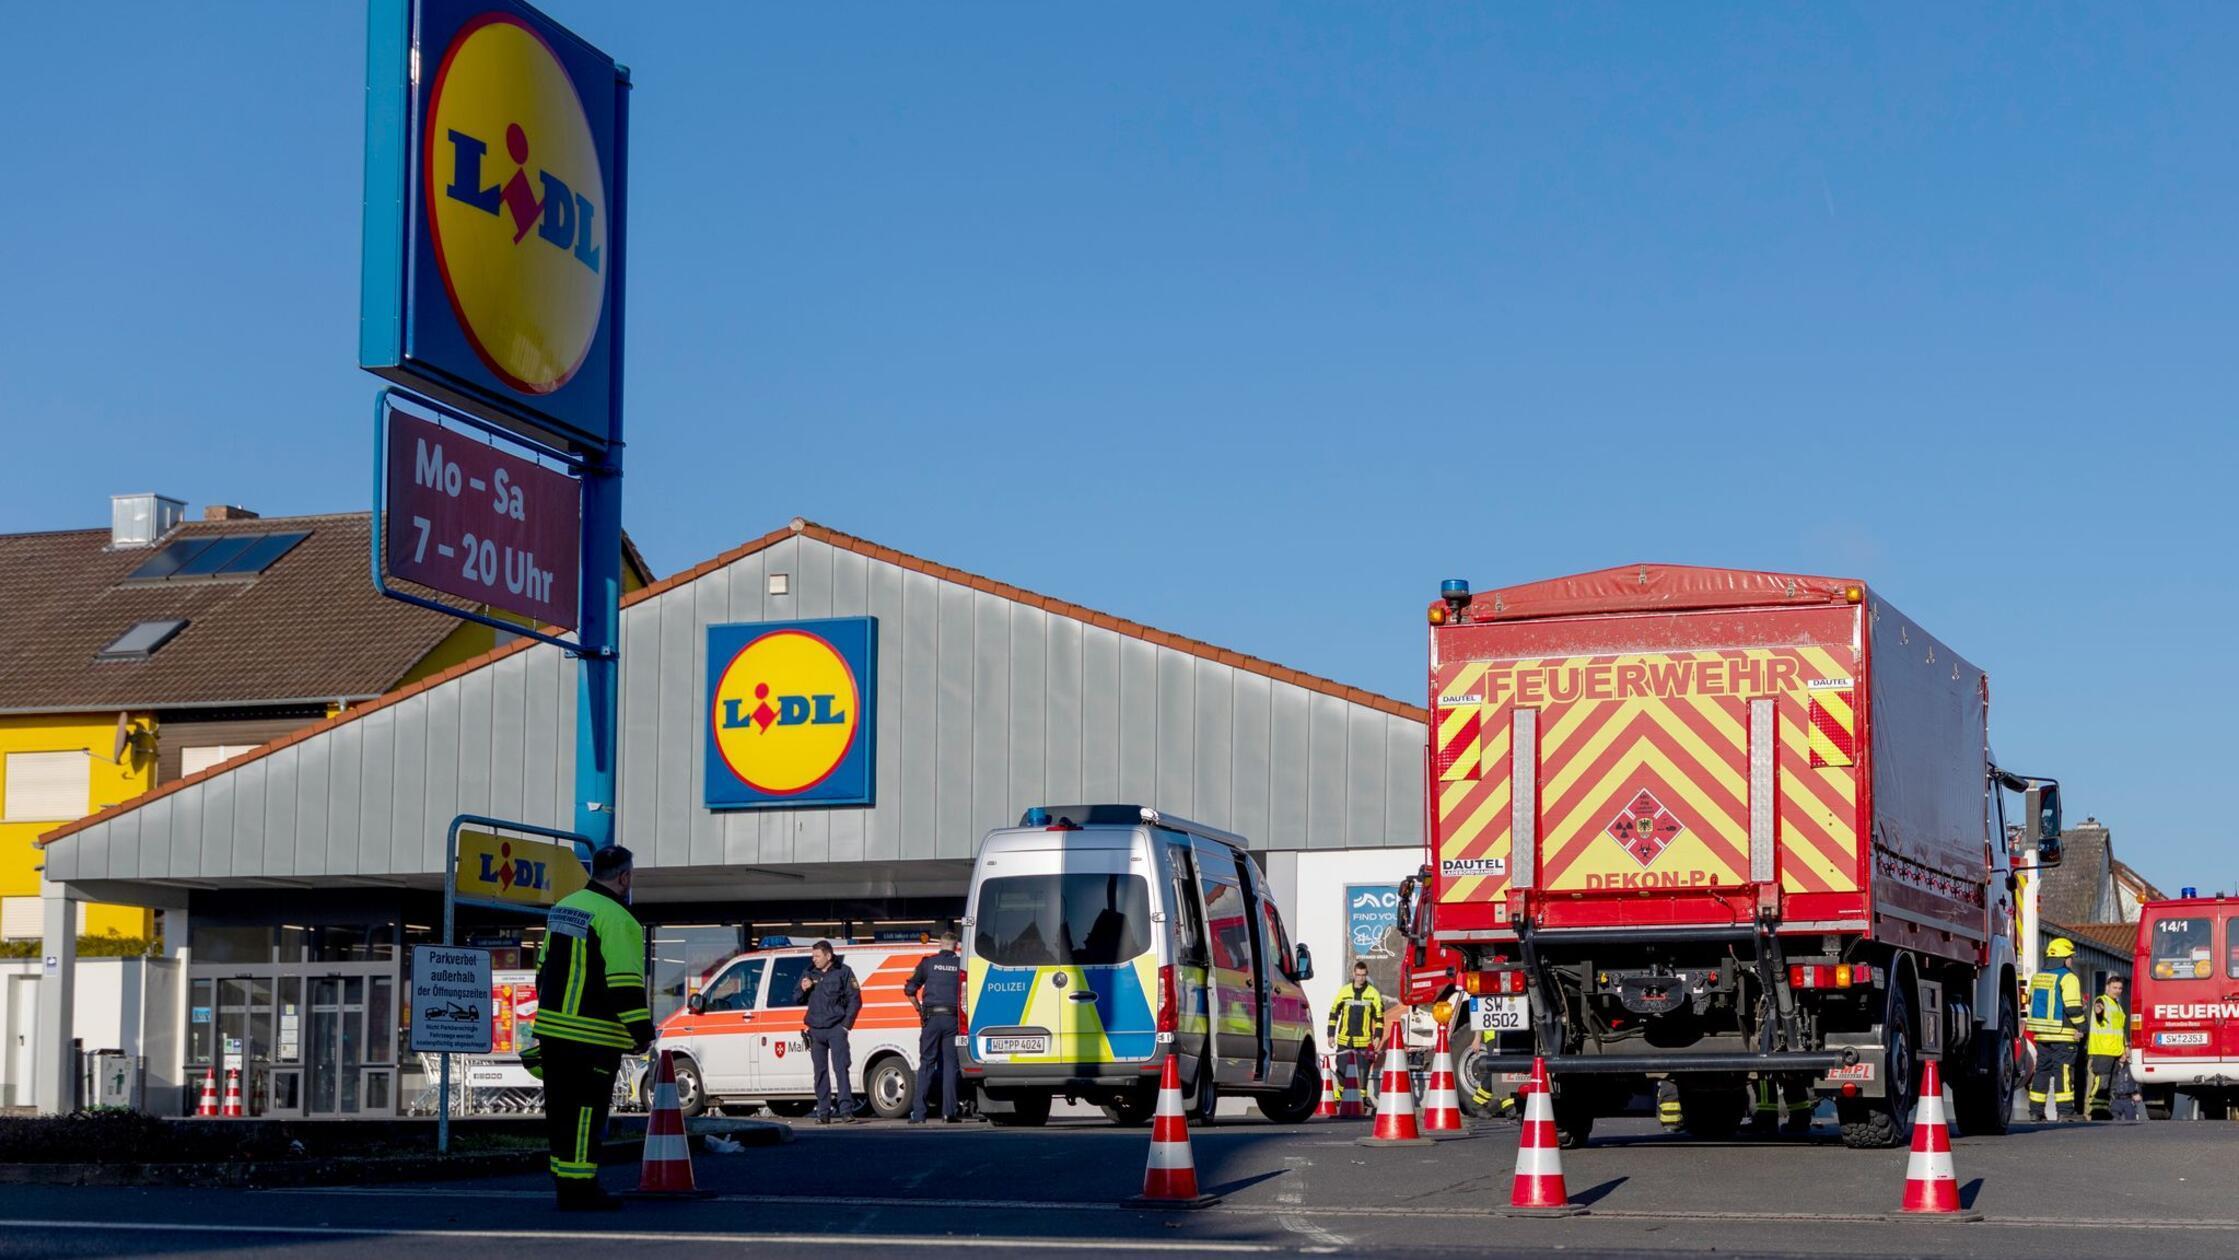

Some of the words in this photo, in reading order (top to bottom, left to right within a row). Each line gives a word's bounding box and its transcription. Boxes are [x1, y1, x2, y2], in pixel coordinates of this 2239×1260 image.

[415, 437, 462, 498] Mo
[493, 468, 526, 522] Sa
[413, 515, 431, 564] 7
[462, 532, 498, 587] 20
[505, 545, 554, 604] Uhr
[1486, 657, 1799, 705] FEUERWEHR
[1812, 678, 1849, 687] DAUTEL
[1442, 695, 1477, 703] DAUTEL
[1442, 858, 1504, 870] DAUTEL
[1585, 870, 1706, 889] DEKON-P
[1353, 912, 1377, 921] FIND
[2159, 920, 2188, 933] 14/1
[429, 950, 477, 967] Parkverbot
[933, 964, 958, 972] POLIZEI
[430, 969, 476, 984] außerhalb
[417, 985, 431, 997] der
[432, 983, 488, 1000] Öffnungszeiten
[988, 982, 1026, 992] POLIZEI
[1484, 996, 1504, 1011] SW
[1482, 1012, 1519, 1028] 8502
[1009, 1040, 1020, 1050] PP
[1021, 1039, 1041, 1050] 4024
[2182, 1034, 2204, 1043] 2353
[788, 1041, 806, 1053] Mal
